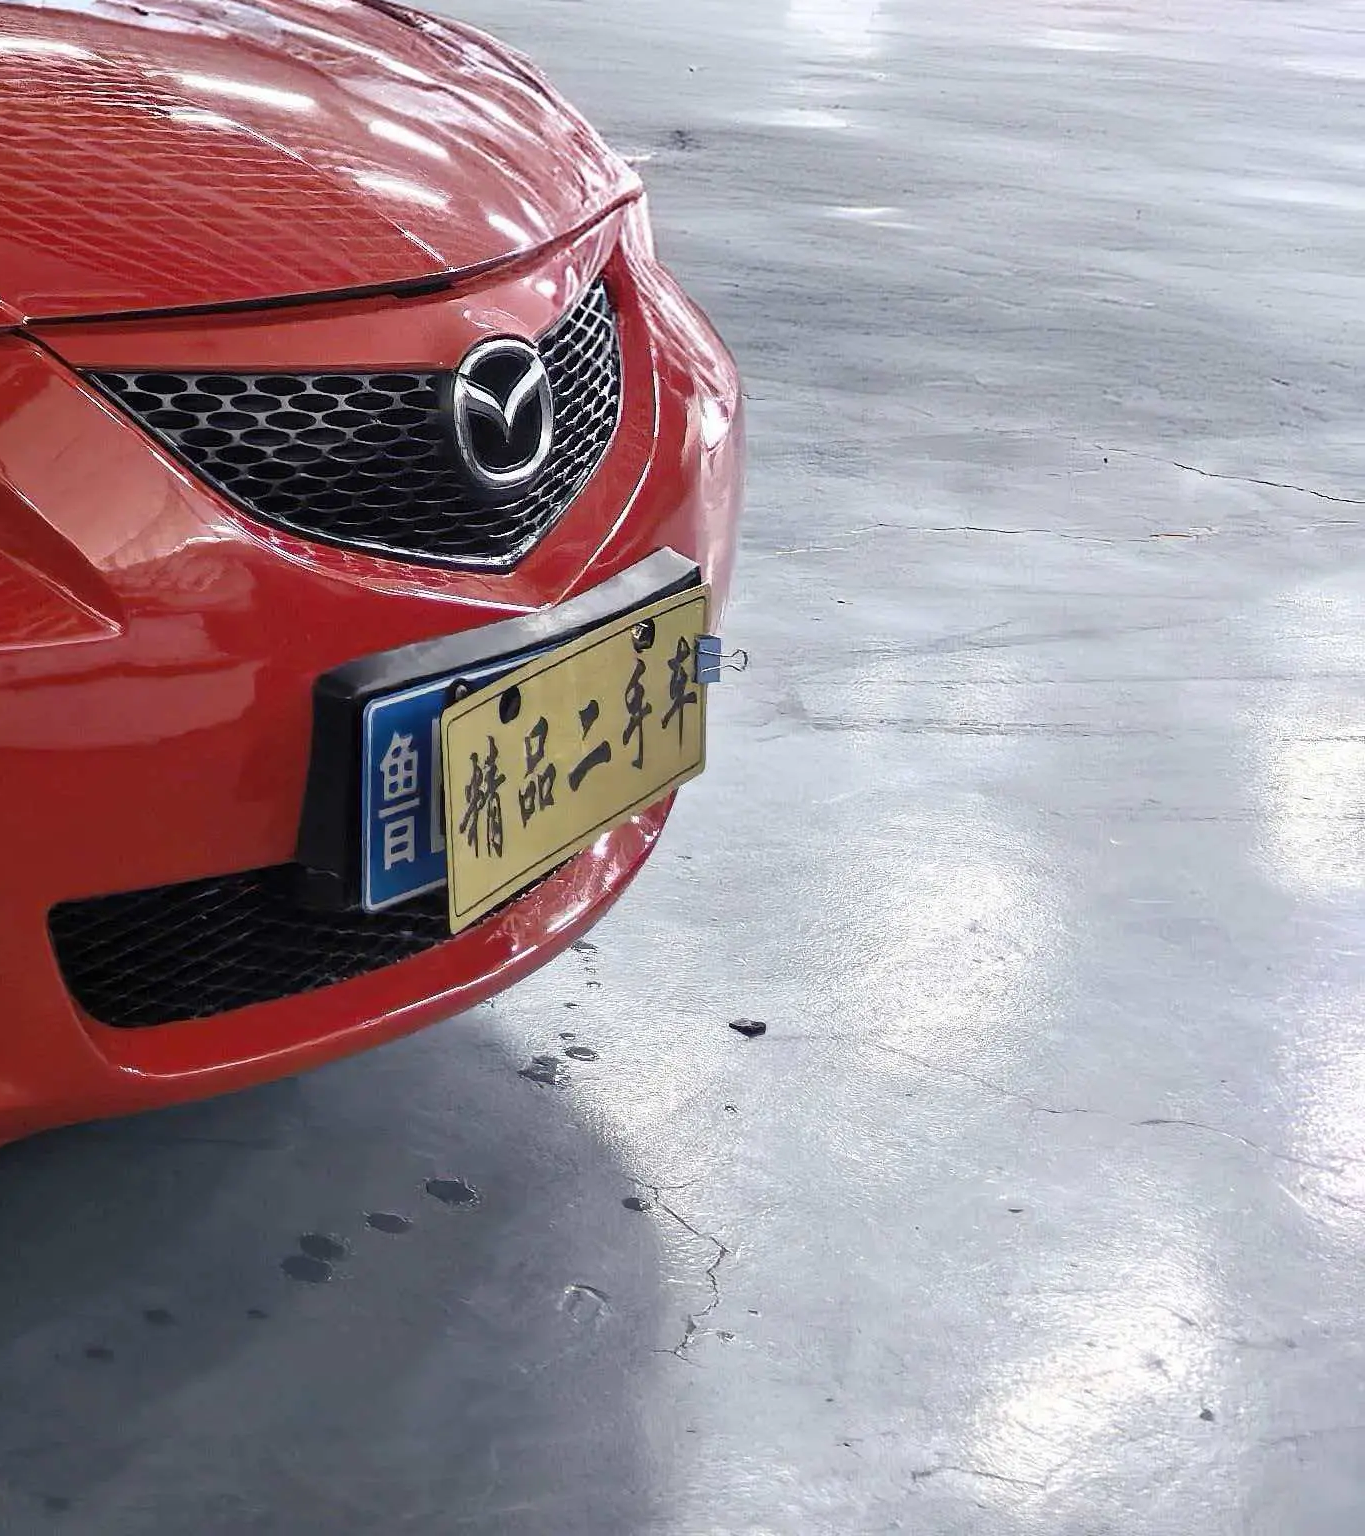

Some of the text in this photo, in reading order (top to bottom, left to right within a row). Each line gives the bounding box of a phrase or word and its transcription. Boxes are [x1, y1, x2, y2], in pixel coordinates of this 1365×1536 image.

[459, 636, 697, 858] 精品二手车
